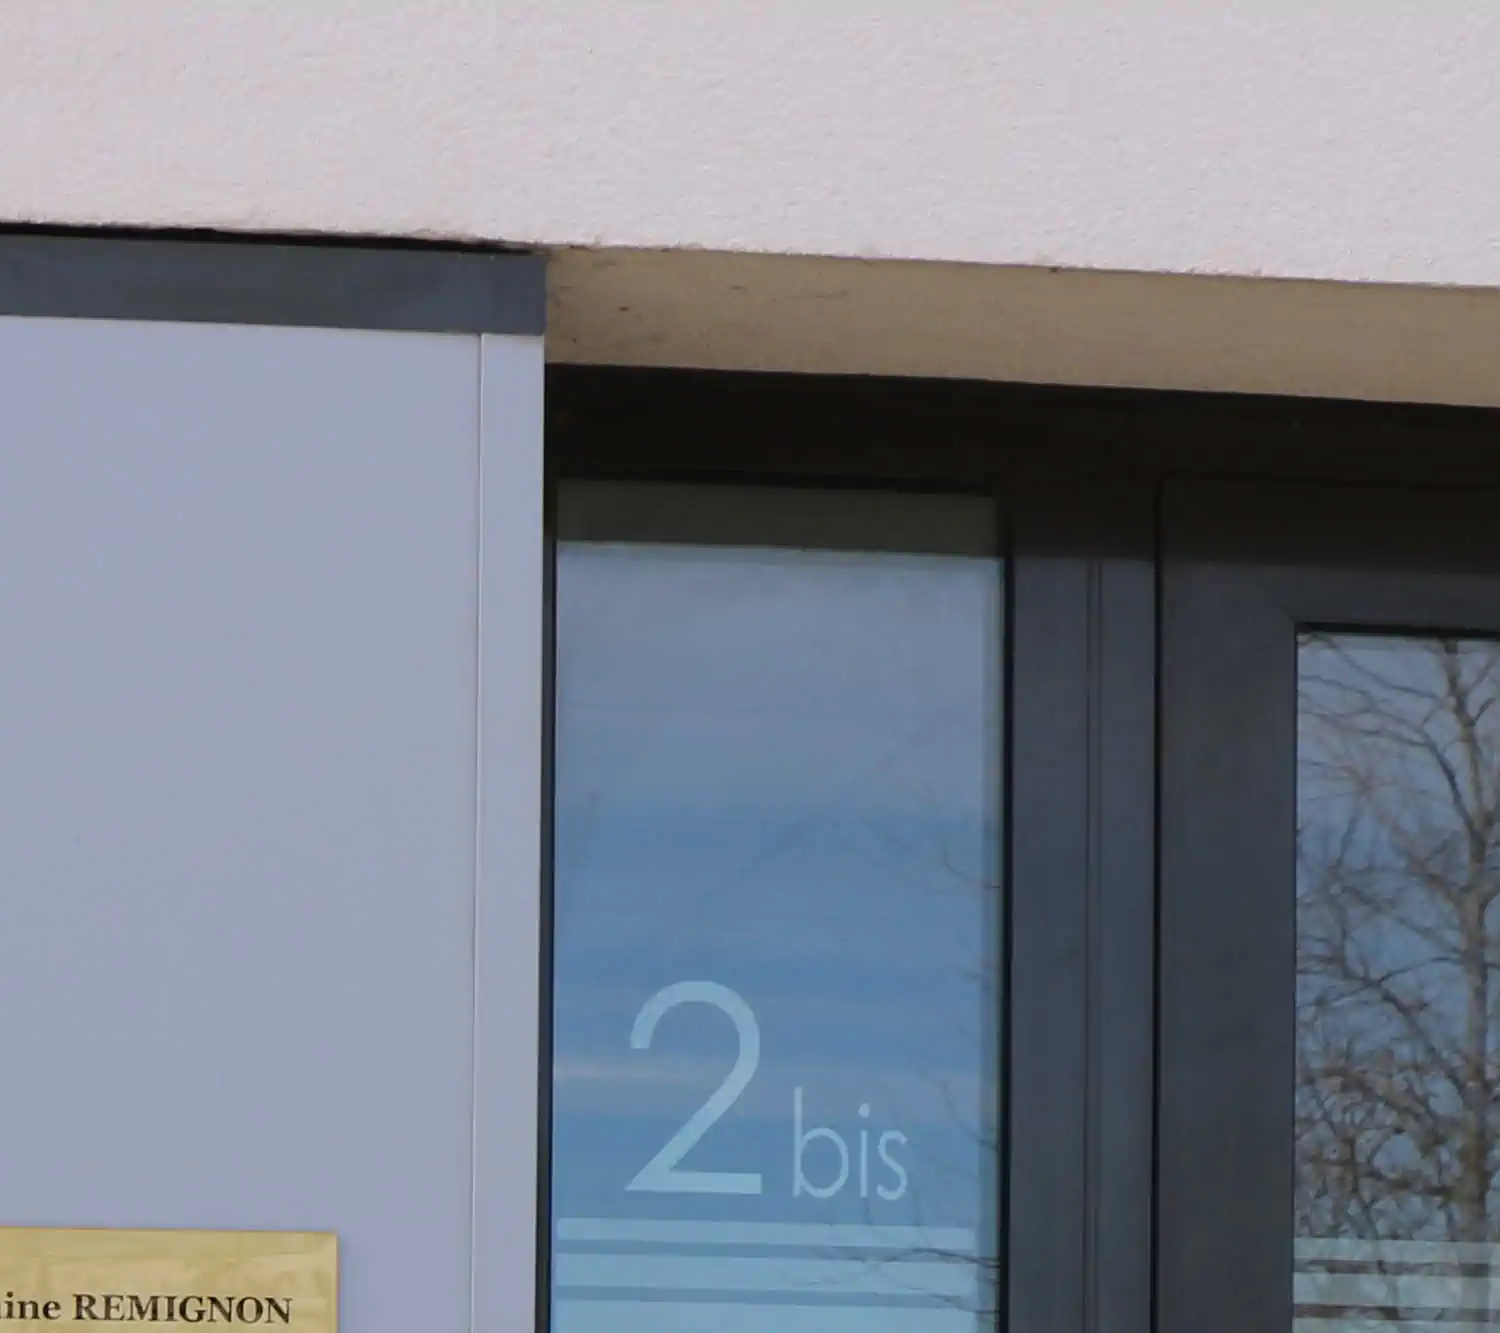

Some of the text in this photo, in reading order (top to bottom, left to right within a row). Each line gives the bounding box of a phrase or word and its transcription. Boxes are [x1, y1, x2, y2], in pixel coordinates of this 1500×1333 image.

[623, 979, 910, 1201] 2 bis
[72, 1293, 293, 1325] REMIGNON
